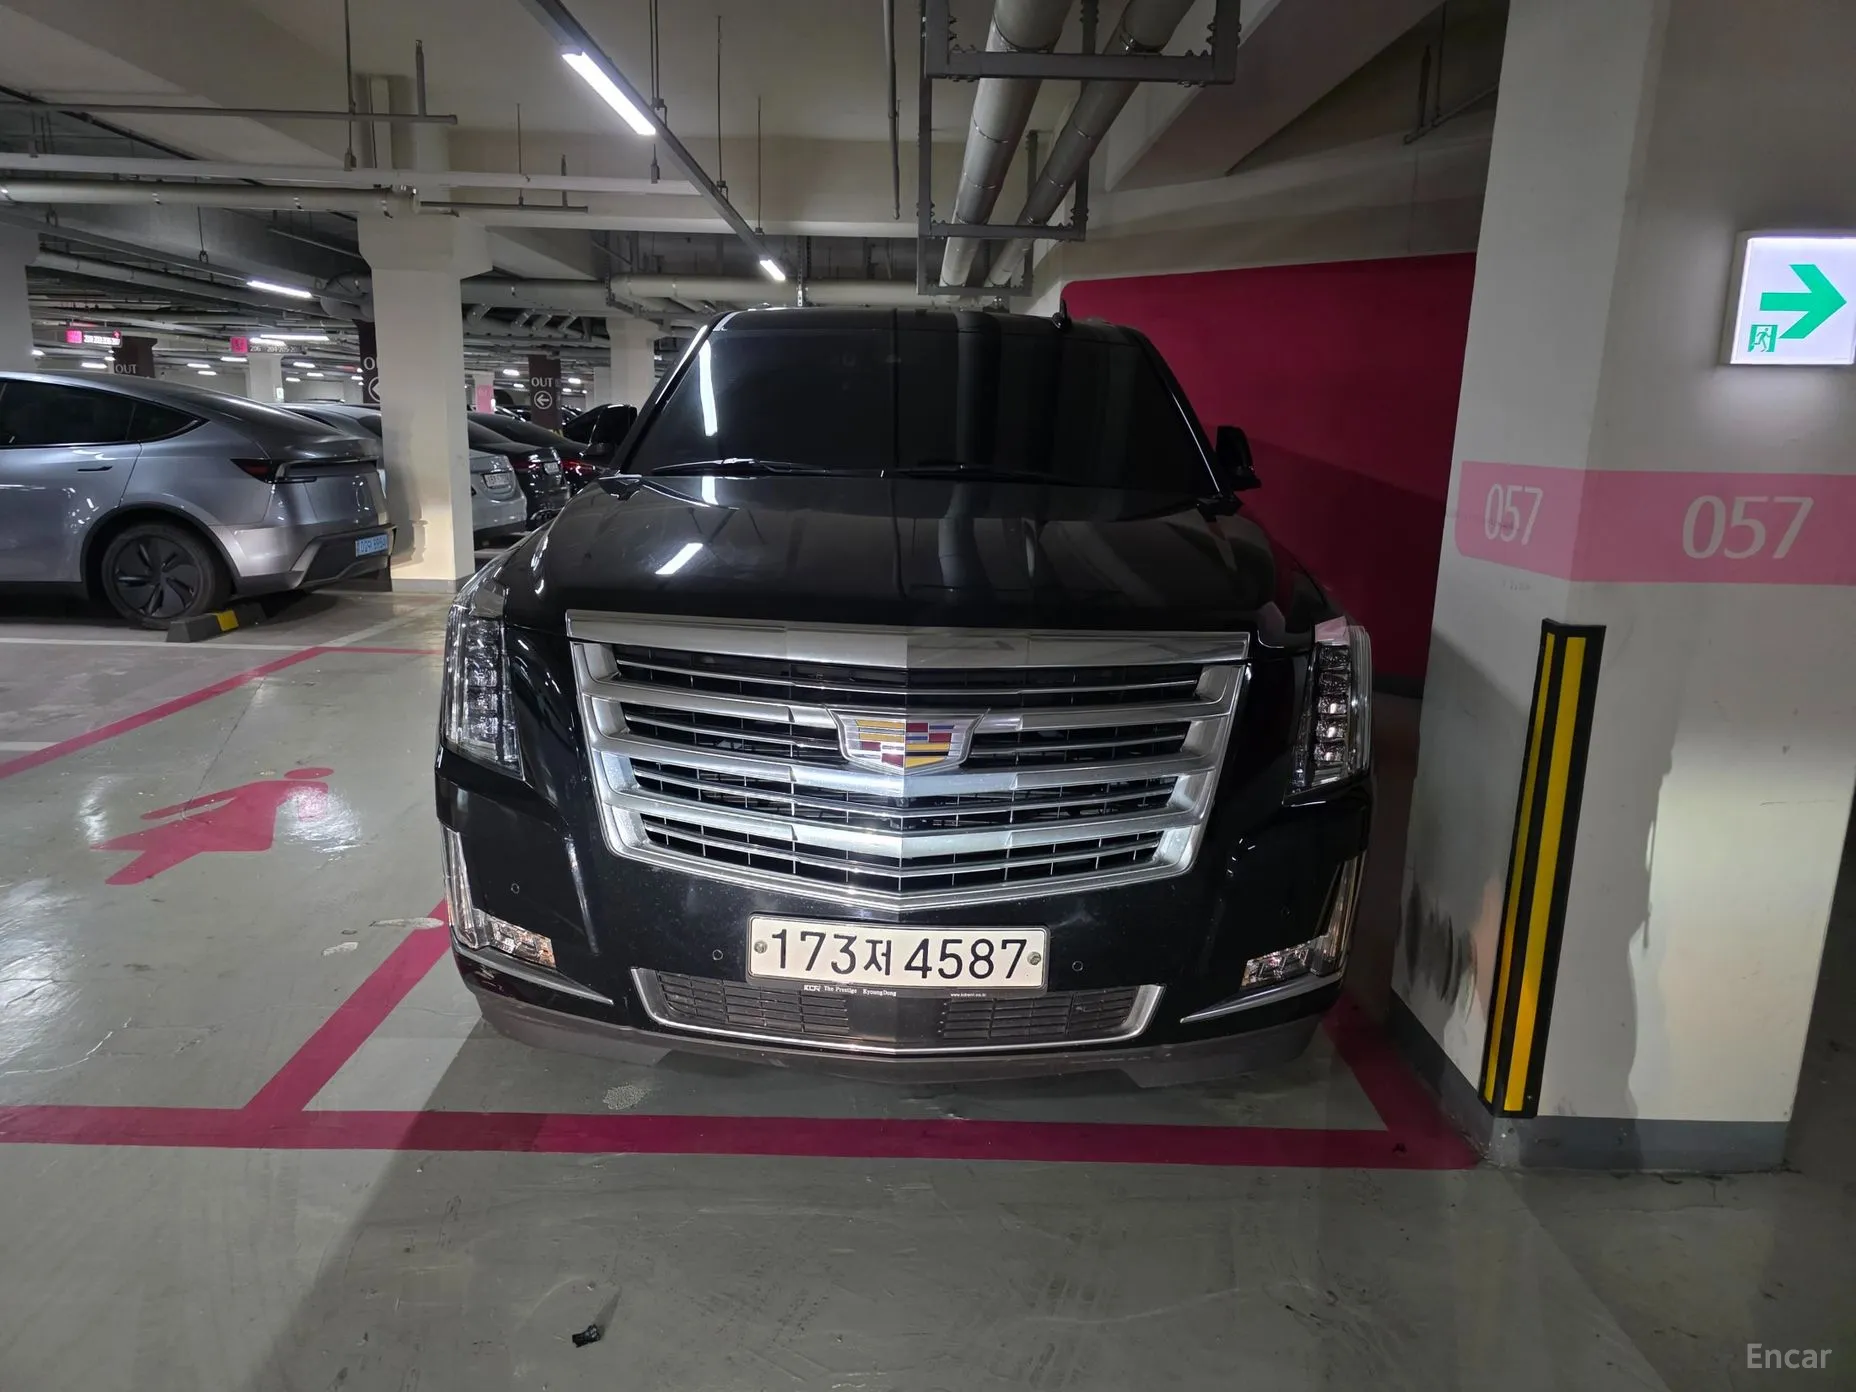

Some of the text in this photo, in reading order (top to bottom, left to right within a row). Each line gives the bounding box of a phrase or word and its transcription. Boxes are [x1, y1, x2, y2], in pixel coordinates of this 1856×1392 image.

[115, 363, 137, 375] OUT
[531, 376, 553, 388] OUT
[1484, 483, 1544, 546] 057
[1681, 495, 1815, 560] 057
[835, 986, 857, 995] Prestige
